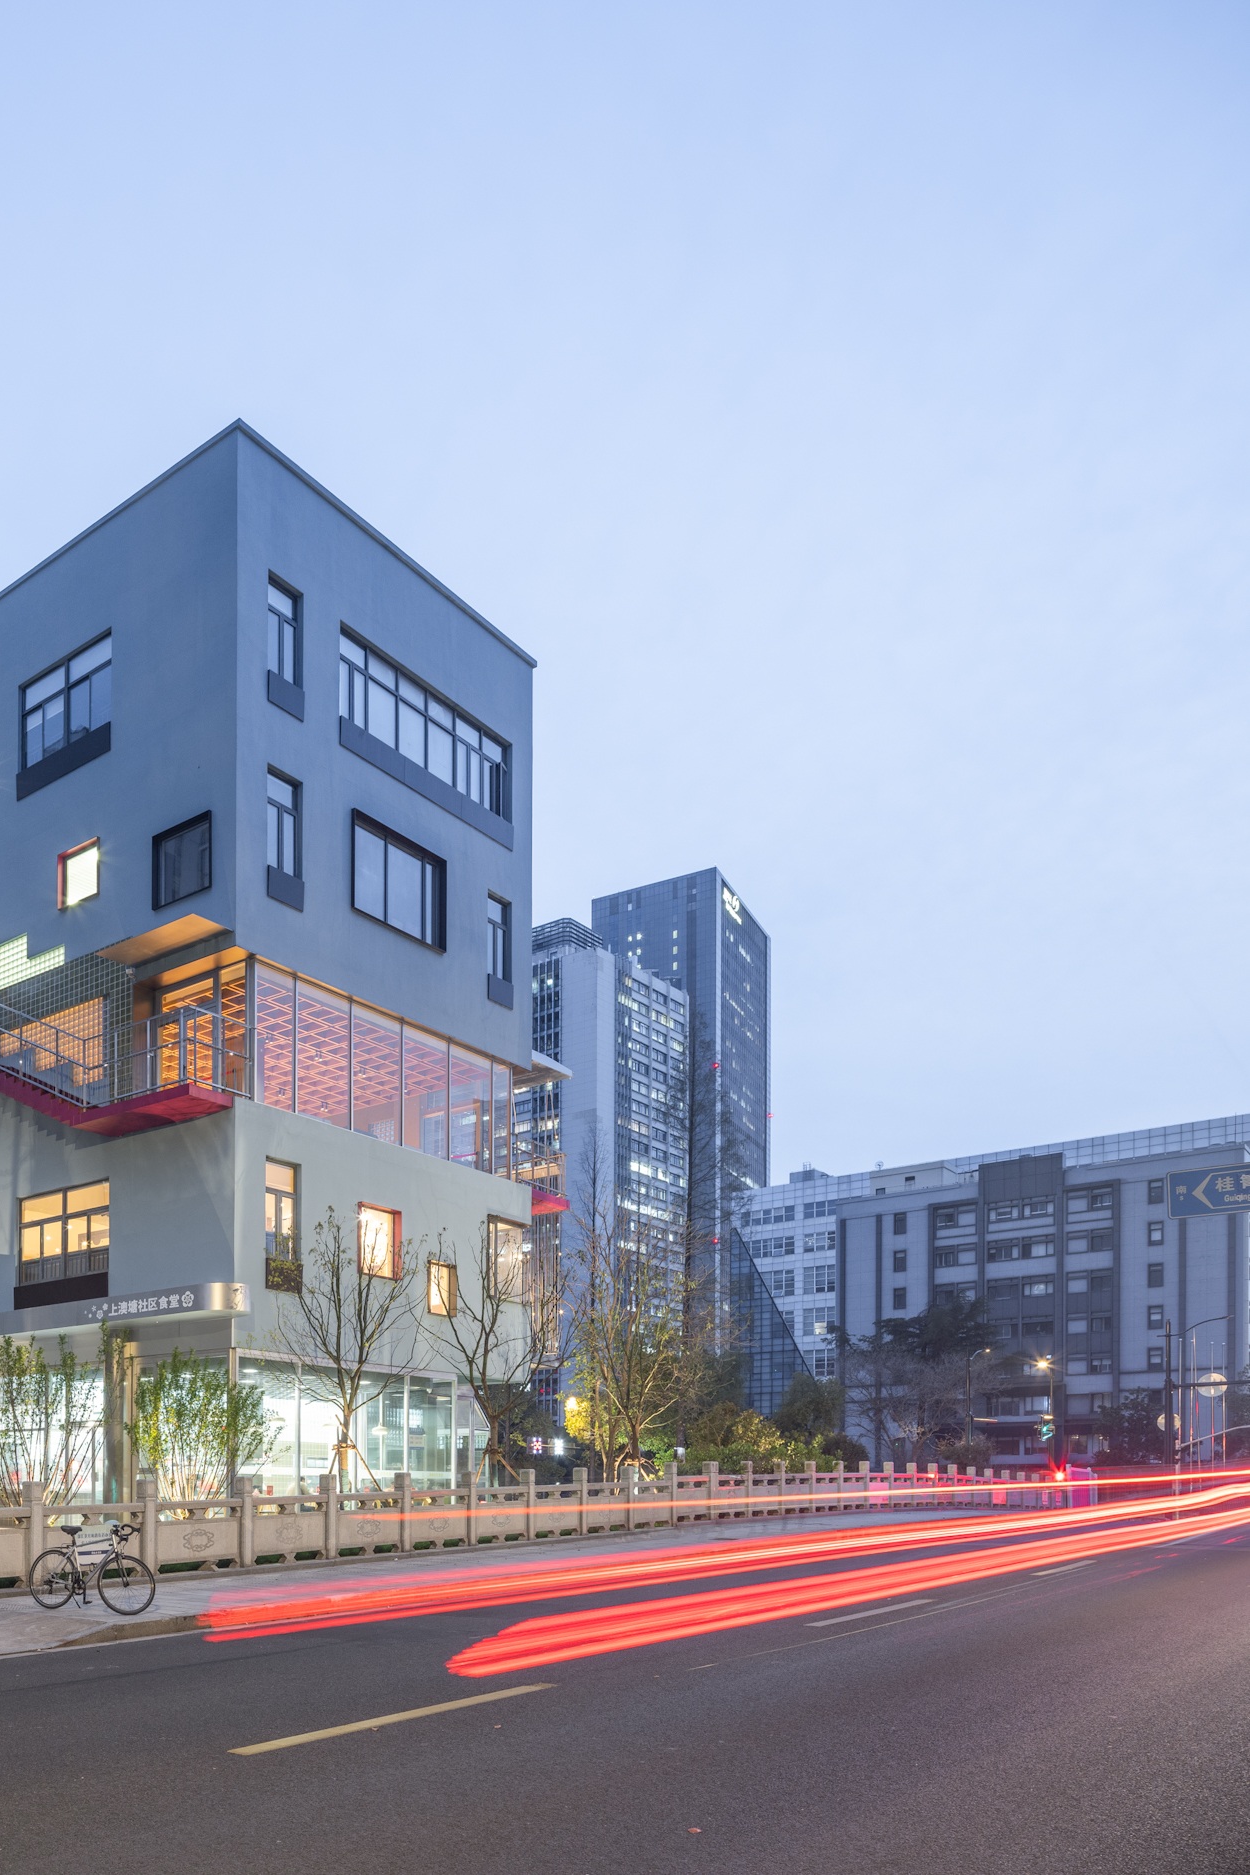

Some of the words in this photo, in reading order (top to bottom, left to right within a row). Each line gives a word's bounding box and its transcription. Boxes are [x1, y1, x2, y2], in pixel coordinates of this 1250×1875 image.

[1175, 1185, 1187, 1195] 南
[108, 1293, 180, 1317] 上澳塘社区食堂
